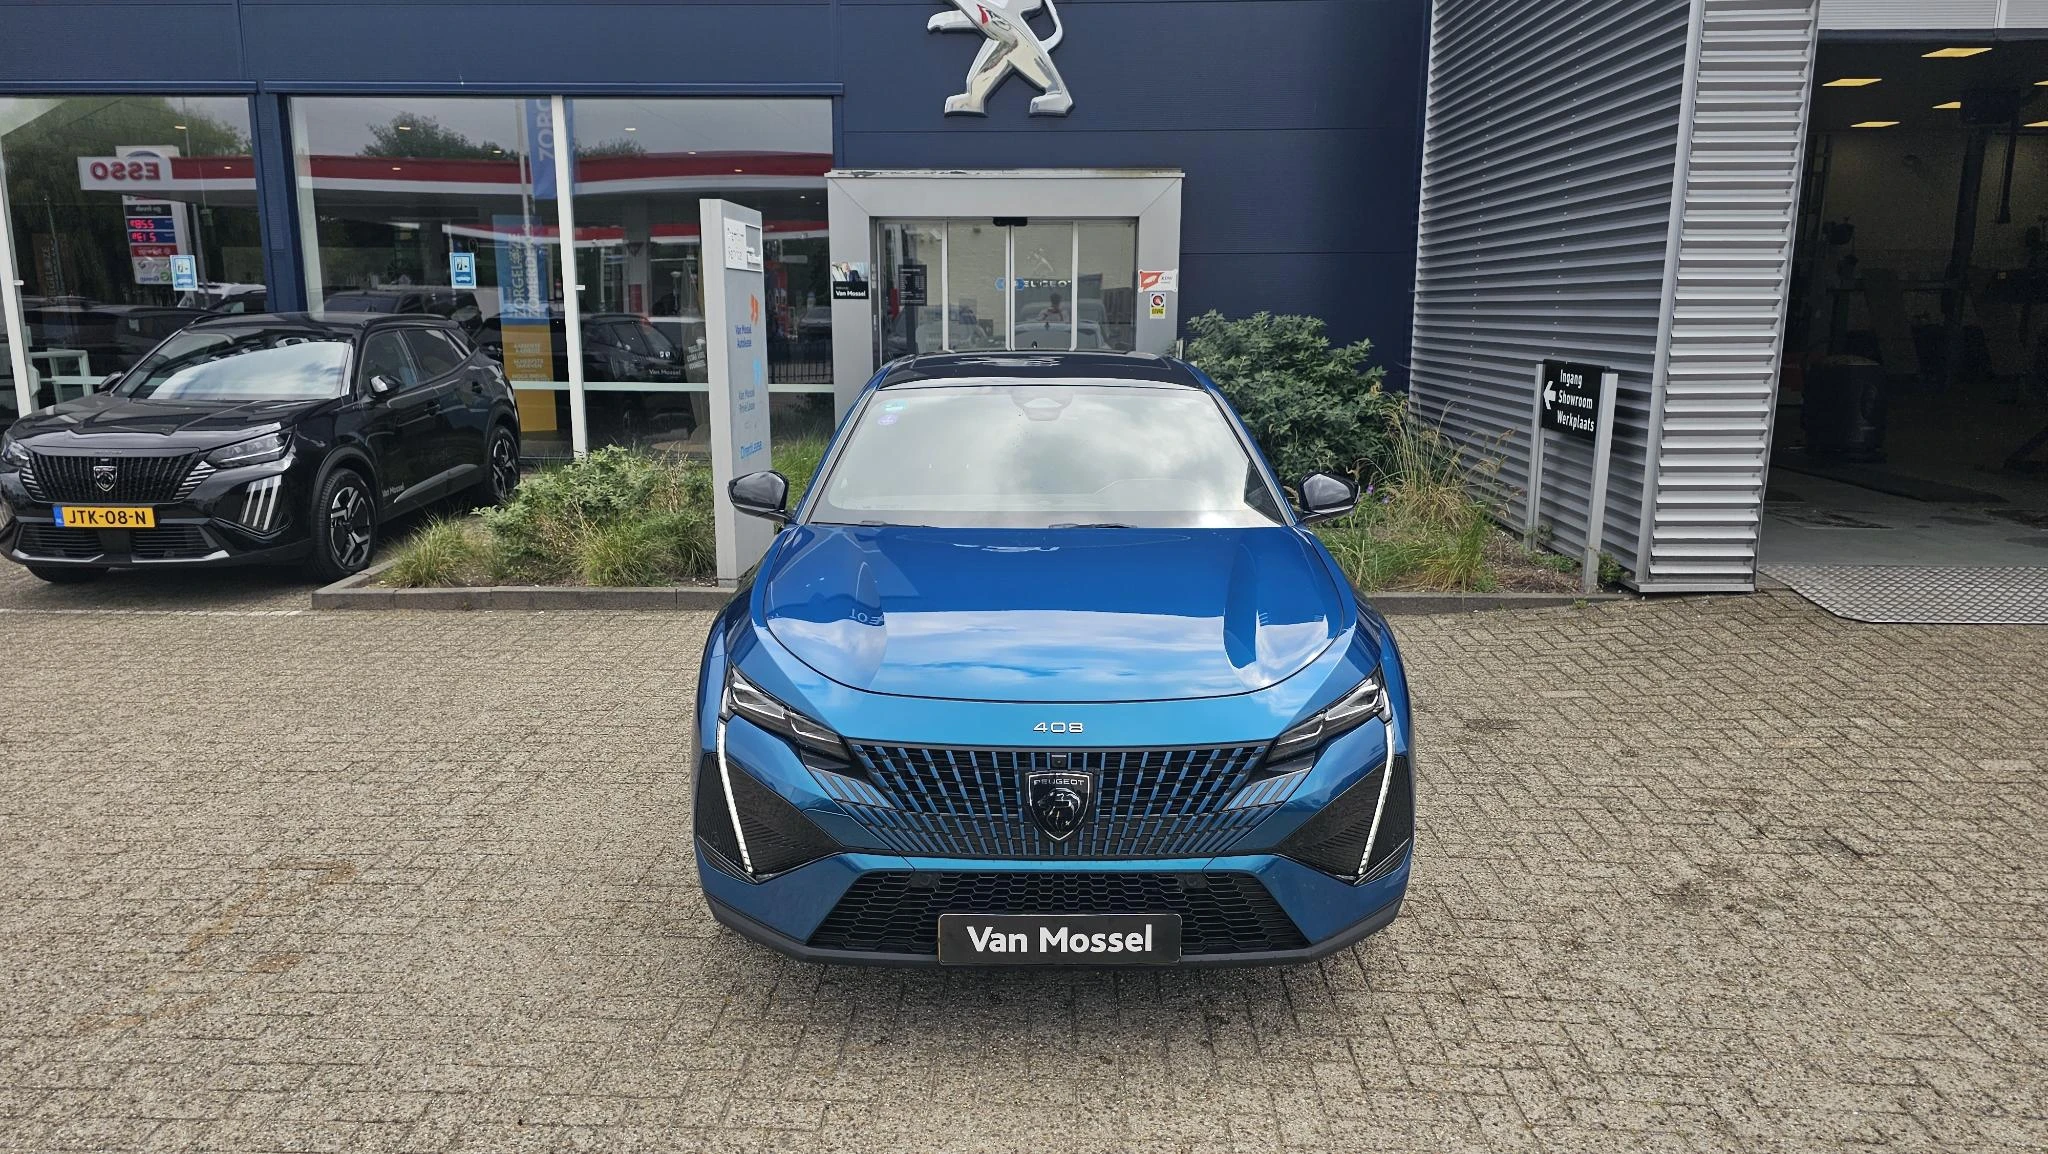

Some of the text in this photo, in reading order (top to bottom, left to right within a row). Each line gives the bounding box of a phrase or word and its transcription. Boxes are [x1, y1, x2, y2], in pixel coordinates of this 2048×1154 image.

[1560, 369, 1583, 389] Ingang
[1558, 389, 1593, 409] Showroom
[1557, 409, 1595, 432] Werkplaats
[69, 510, 147, 525] JTK-08-N
[1033, 722, 1084, 733] 408
[966, 924, 1153, 953] Van Mossel
